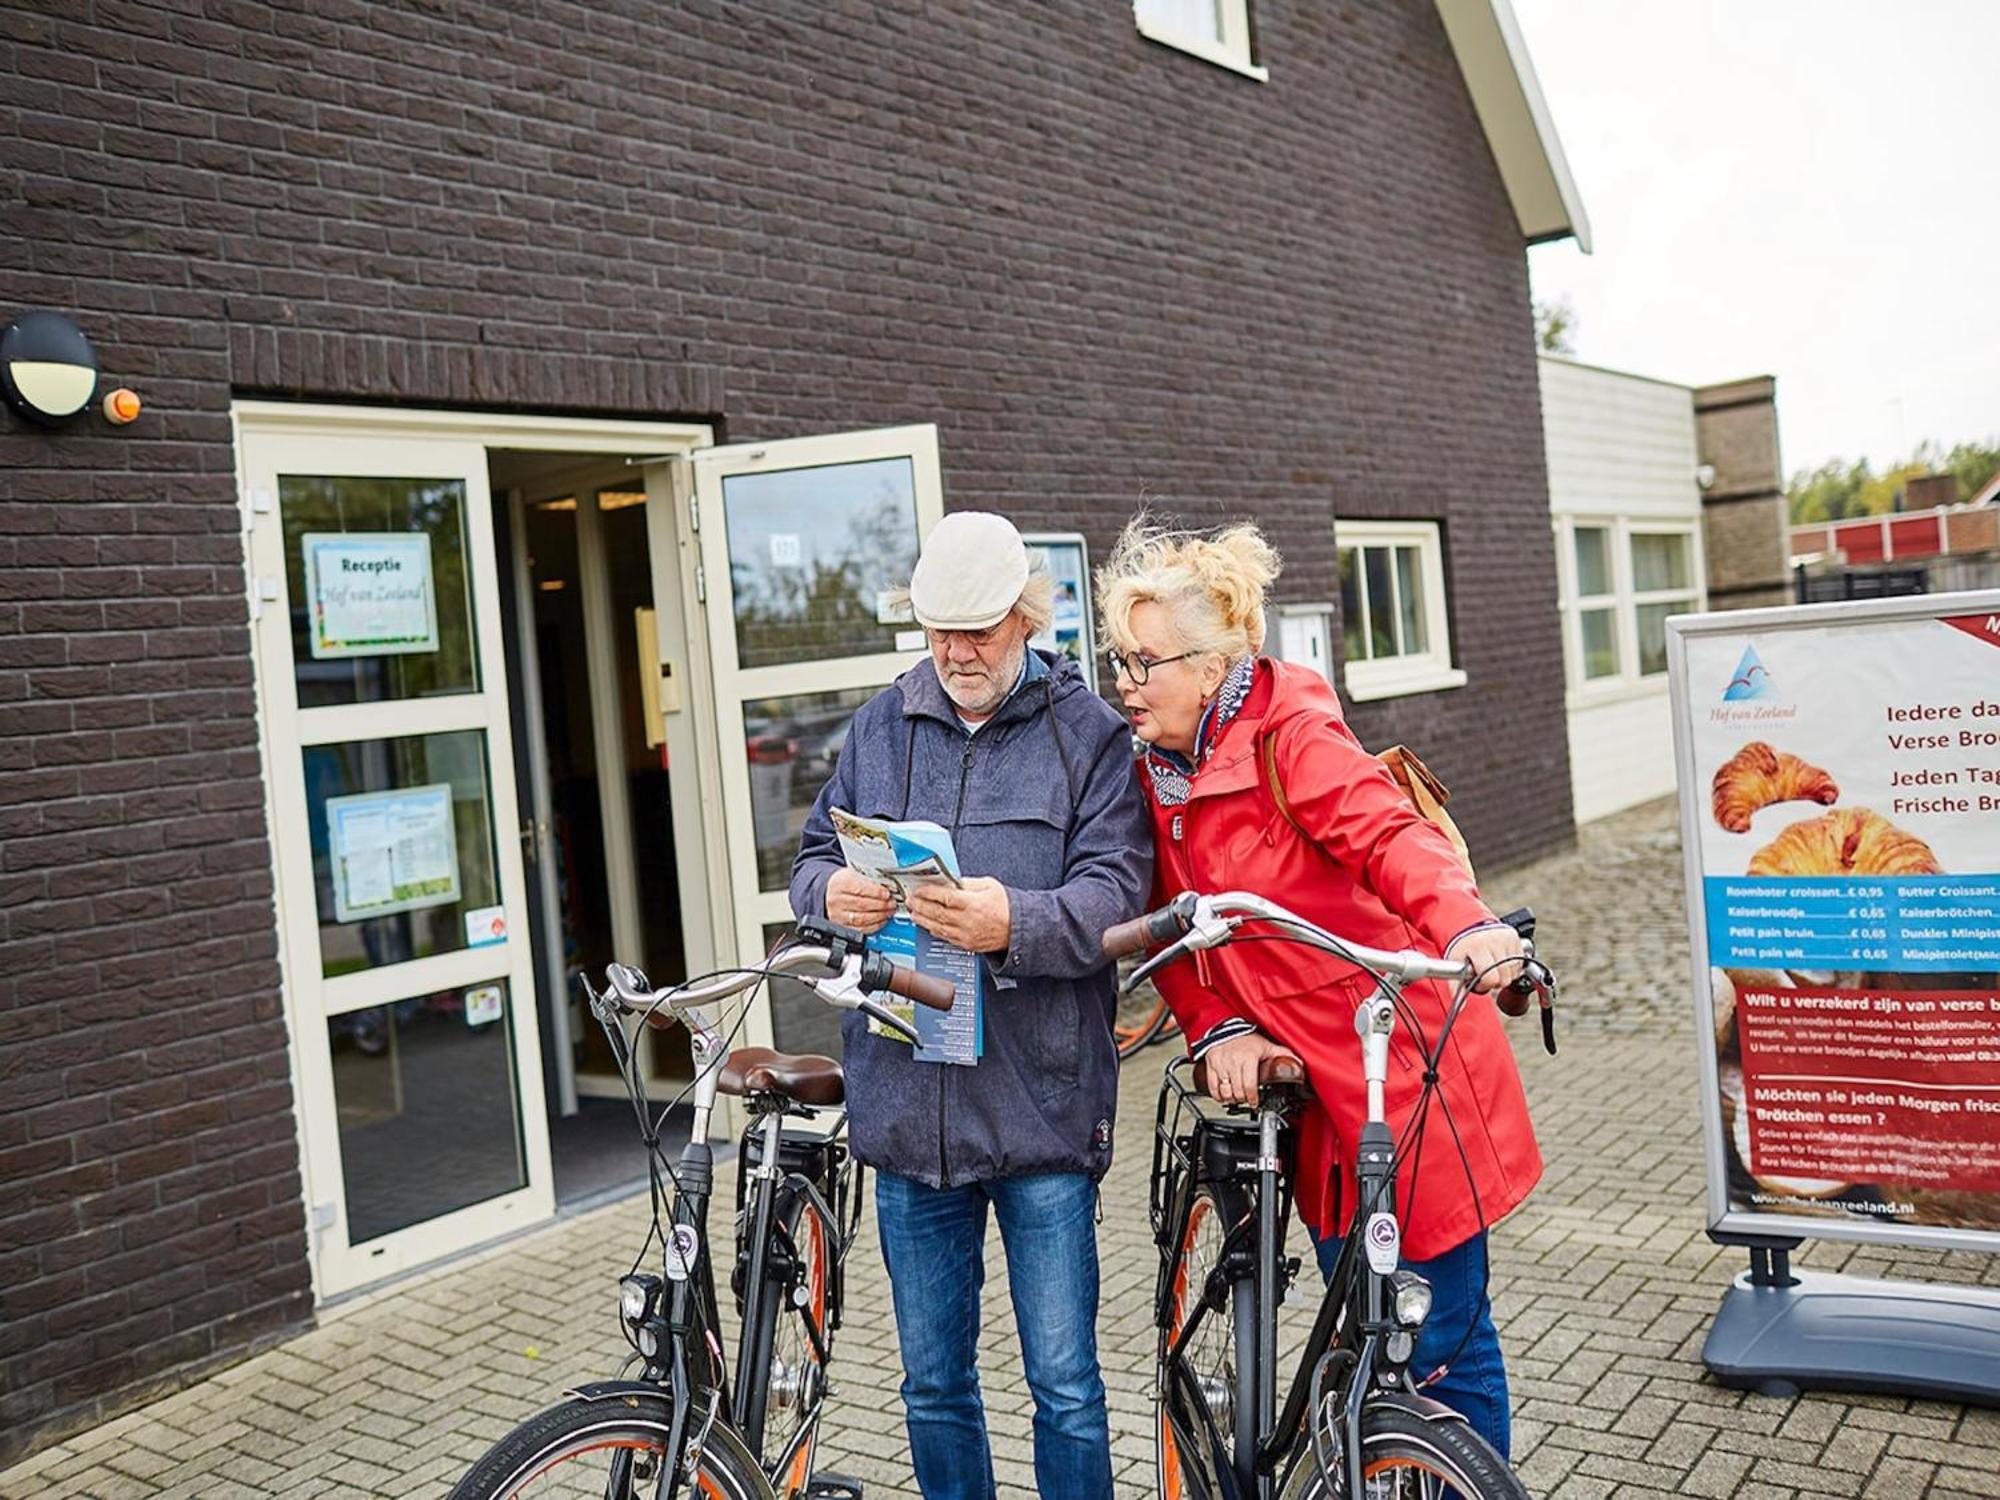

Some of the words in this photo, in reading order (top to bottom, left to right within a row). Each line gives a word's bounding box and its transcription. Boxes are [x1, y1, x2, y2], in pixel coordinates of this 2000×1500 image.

[342, 558, 401, 575] Receptie
[1710, 708, 1731, 723] Hof
[1732, 710, 1751, 720] van
[1752, 704, 1797, 720] Zeeland
[1887, 704, 1962, 722] Iedere
[1888, 734, 1950, 750] Verse
[1959, 730, 2000, 747] Bro
[1890, 769, 1958, 787] Jeden
[1893, 797, 1969, 814] Frische
[1897, 887, 1937, 898] Butter
[1757, 928, 1782, 939] pain
[1744, 993, 1777, 1008] Wilt
[1780, 997, 1791, 1008] u
[1794, 995, 1870, 1011] verzekerd
[1873, 997, 1902, 1014] zijn
[1905, 1001, 1936, 1012] van
[1940, 1001, 1985, 1012] verse
[1951, 1037, 1976, 1047] voor
[1754, 1087, 1822, 1101] Möchten
[1825, 1090, 1847, 1103] sie
[1850, 1091, 1895, 1106] jeden
[1898, 1094, 1961, 1113] Morgen
[1756, 1108, 1825, 1123] Brötchen
[1827, 1112, 1873, 1125] essen
[1876, 1112, 1887, 1126] ?
